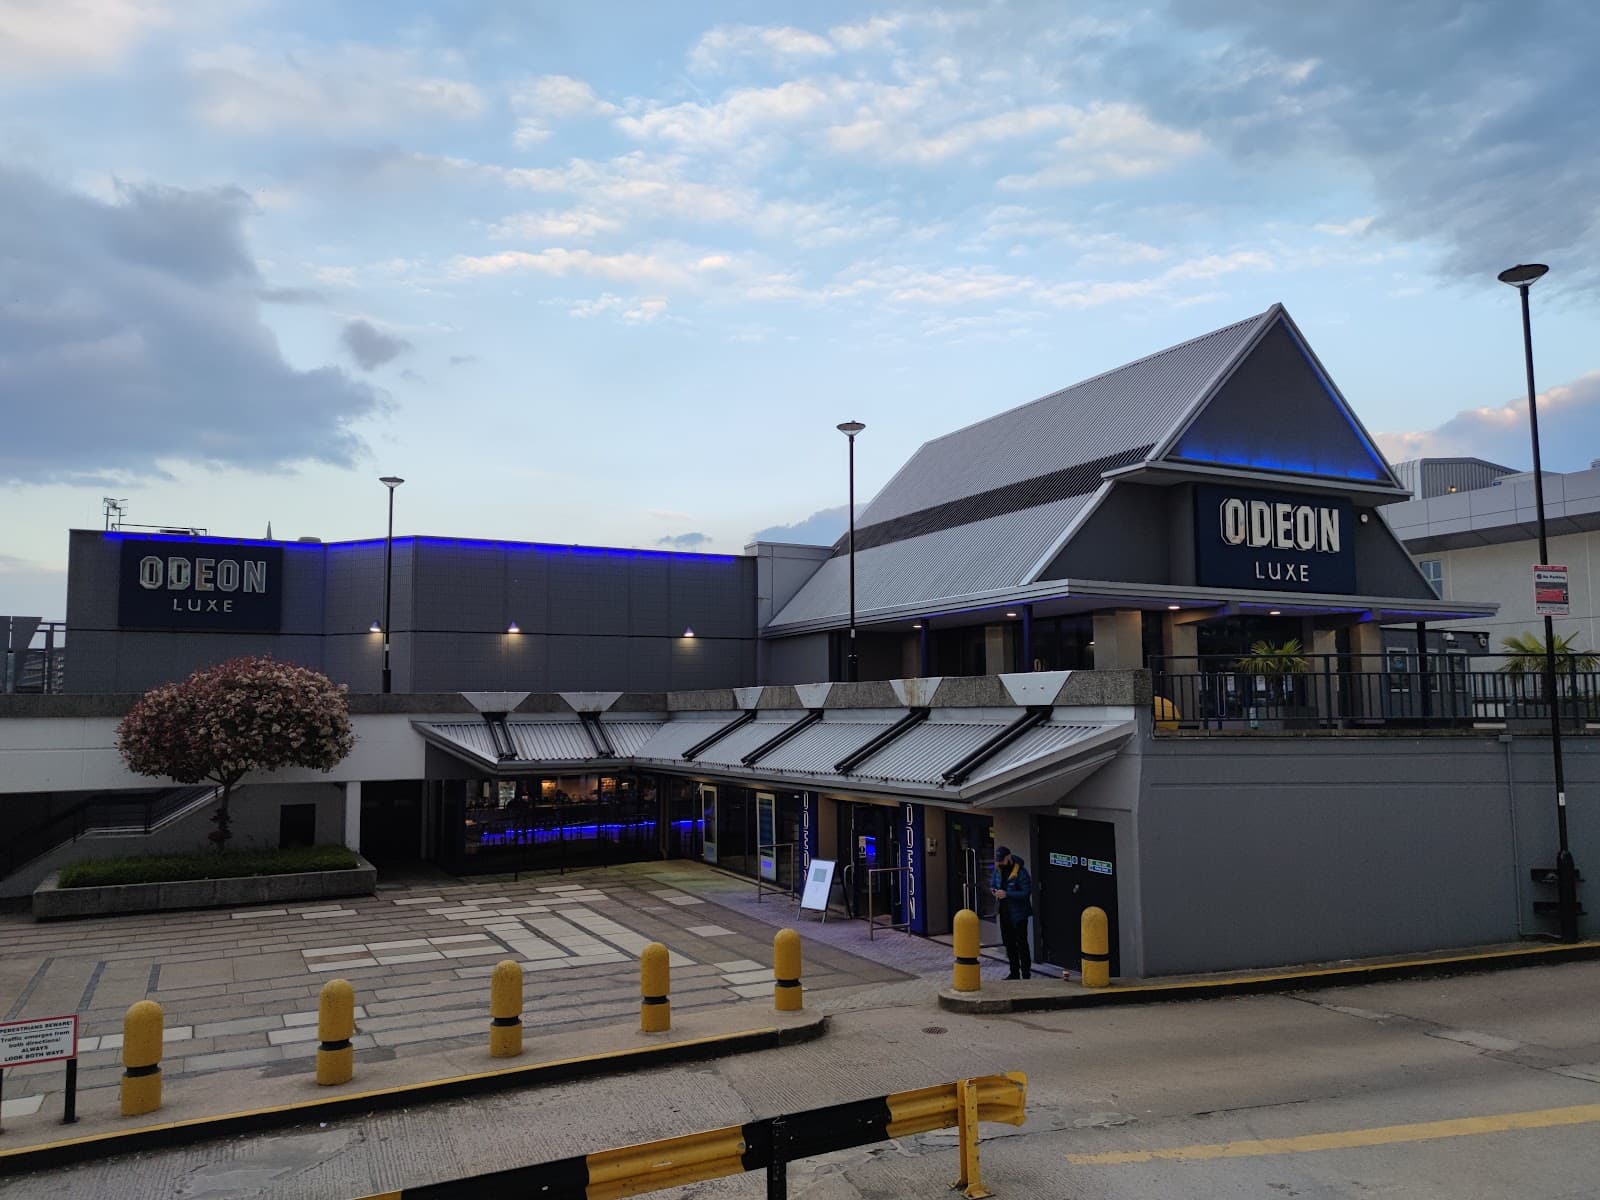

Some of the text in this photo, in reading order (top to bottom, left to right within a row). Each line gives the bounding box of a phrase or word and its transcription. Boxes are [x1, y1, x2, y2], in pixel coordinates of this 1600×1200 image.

[1220, 498, 1340, 553] ODEON
[139, 555, 267, 593] ODEON
[1255, 561, 1310, 582] LUXE
[173, 598, 233, 613] LUXE
[24, 1032, 53, 1040] emerges
[21, 1045, 48, 1053] ALWAYS
